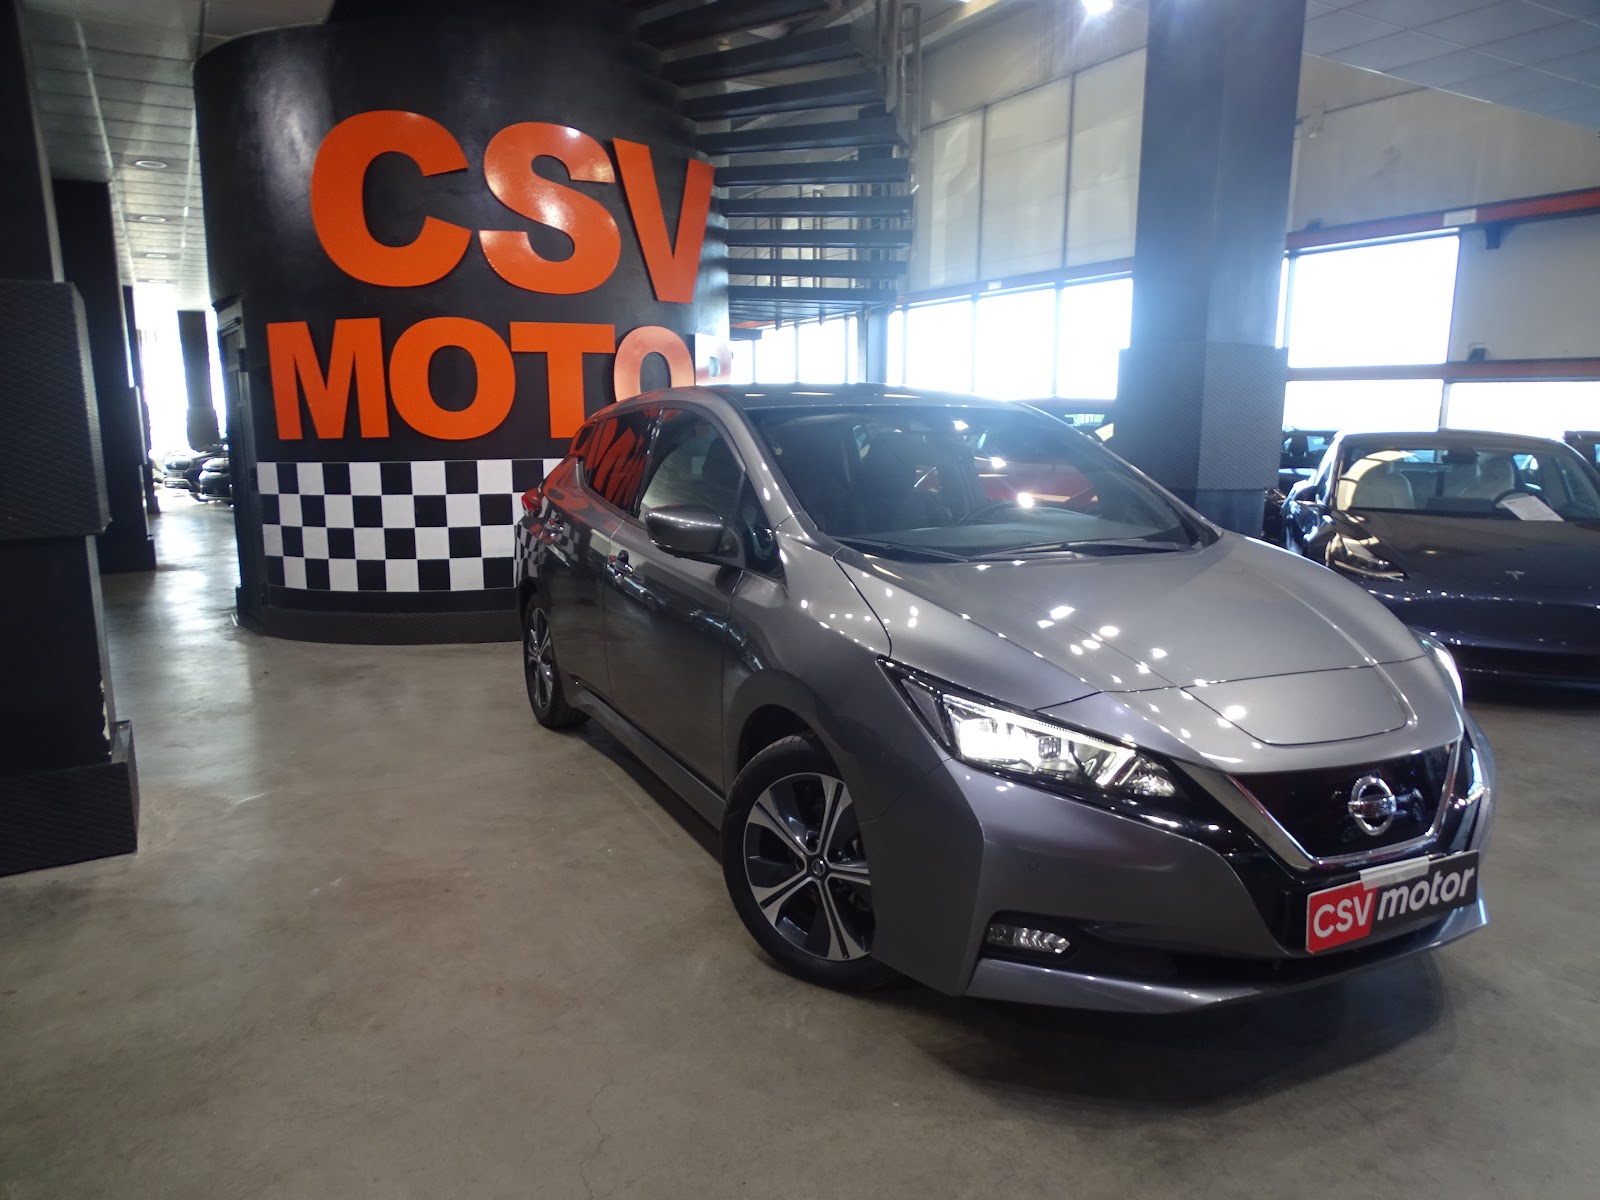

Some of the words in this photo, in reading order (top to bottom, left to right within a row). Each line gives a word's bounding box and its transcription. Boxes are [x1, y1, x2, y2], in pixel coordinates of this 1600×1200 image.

[310, 110, 716, 303] CSV
[1313, 892, 1373, 938] CSV
[1377, 867, 1475, 921] motor
